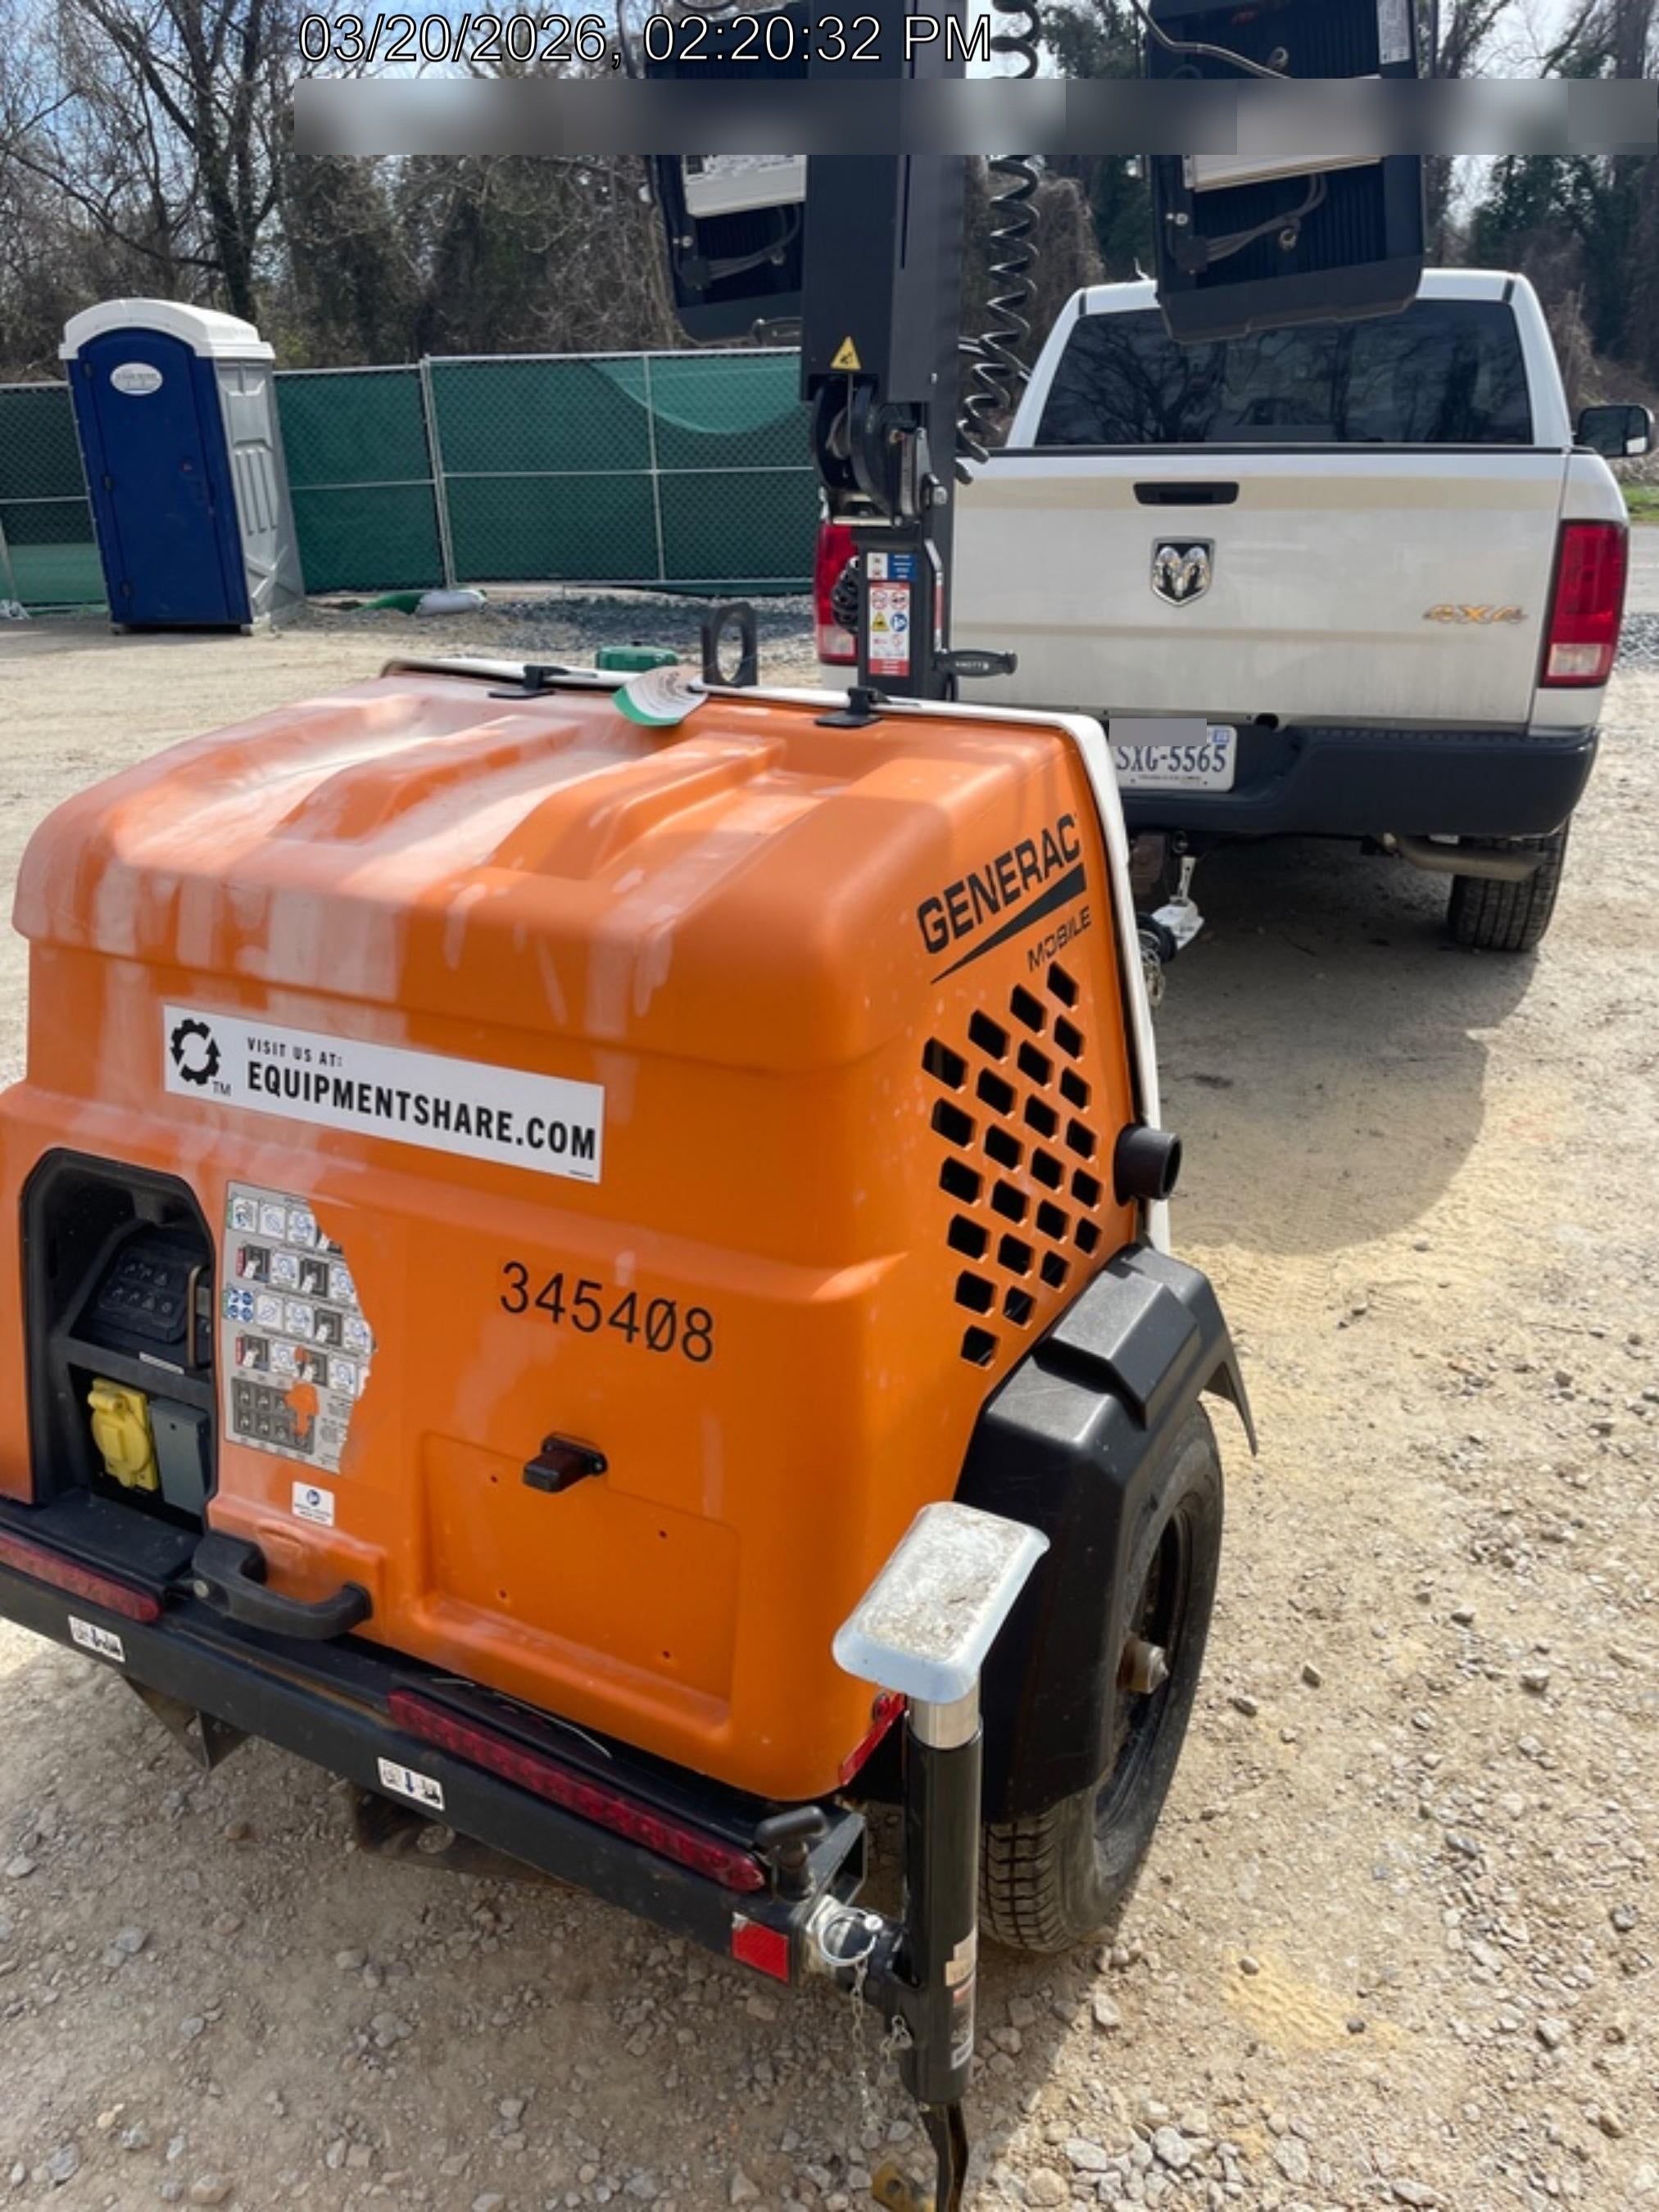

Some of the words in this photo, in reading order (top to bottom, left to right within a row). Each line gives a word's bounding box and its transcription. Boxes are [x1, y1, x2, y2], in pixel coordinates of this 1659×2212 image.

[1116, 744, 1227, 773] SXG-5565
[916, 813, 1081, 954] GENERAC
[1027, 904, 1091, 972] MOBILE
[247, 1036, 287, 1058] VISIT
[292, 1046, 313, 1063] US
[319, 1051, 343, 1067] AT:
[212, 1080, 232, 1097] TM
[247, 1060, 596, 1161] EQUIPMENTSHARE.COM
[501, 1261, 714, 1363] 345408
